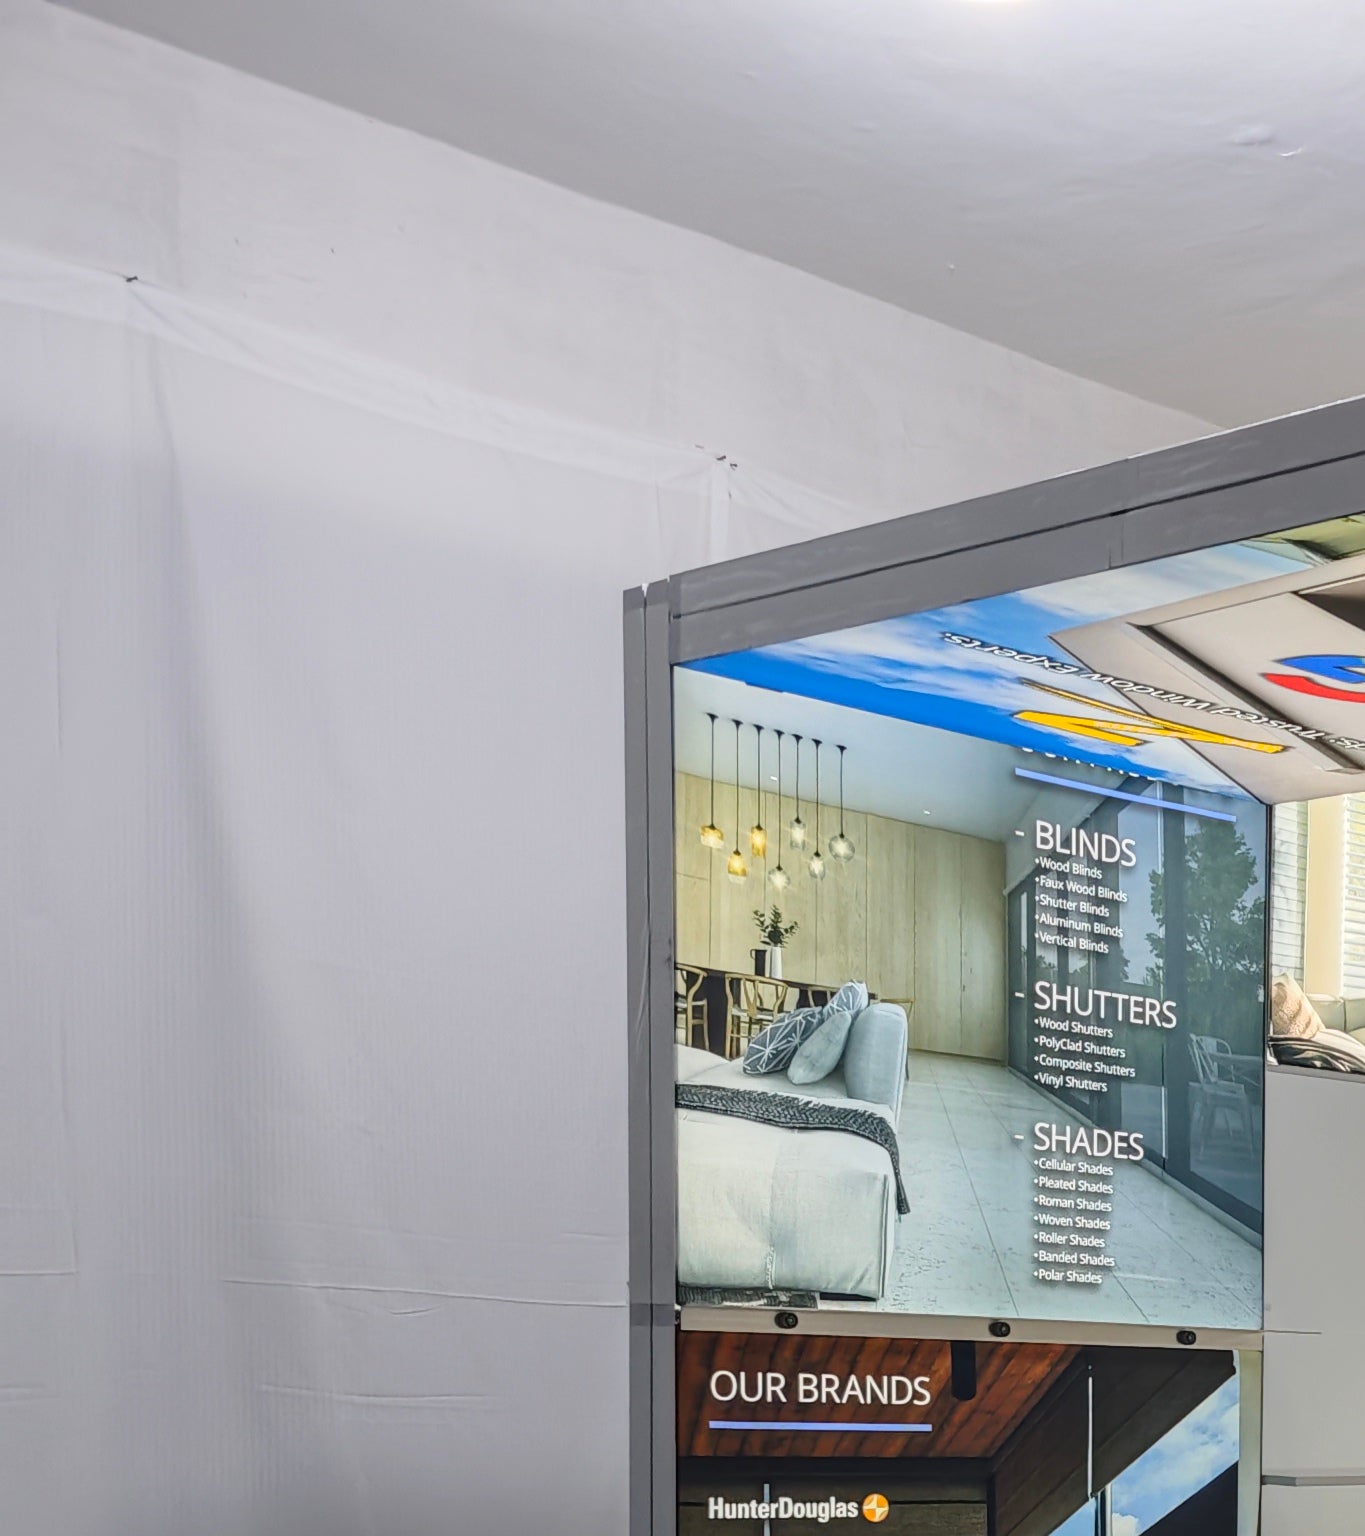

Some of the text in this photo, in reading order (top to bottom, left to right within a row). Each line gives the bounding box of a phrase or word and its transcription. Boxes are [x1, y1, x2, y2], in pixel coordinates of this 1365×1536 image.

[943, 632, 1079, 675] Experts.
[1081, 673, 1211, 712] Window
[1210, 707, 1326, 741] Trusted
[1035, 819, 1137, 867] BLINDS
[1039, 856, 1103, 879] Wood Blinds
[1039, 876, 1128, 902] Faux Wood Blinds
[1039, 895, 1110, 918] Shutter Blinds
[1039, 912, 1124, 938] Aluminum Blinds
[1039, 931, 1110, 954] Vertical Blinds
[1034, 980, 1178, 1029] SHUTTERS
[1039, 1016, 1113, 1038] Wood Shutters
[1039, 1035, 1126, 1058] PolyClad Shutters
[1039, 1054, 1136, 1078] Composite Shutters
[1039, 1072, 1108, 1092] Vinyl Shutters
[1034, 1122, 1144, 1161] SHADES
[1038, 1157, 1113, 1176] Cellular Shades
[1039, 1176, 1113, 1194] Pleated Shades
[1039, 1195, 1112, 1212] Roman Shades
[1039, 1213, 1111, 1230] Woven Shades
[1039, 1232, 1105, 1248] Roller Shades
[1039, 1250, 1115, 1267] Banded Shades
[1039, 1269, 1102, 1284] Polar Shades
[709, 1370, 932, 1406] OUR BRANDS
[708, 1496, 859, 1523] HunterDouglas
